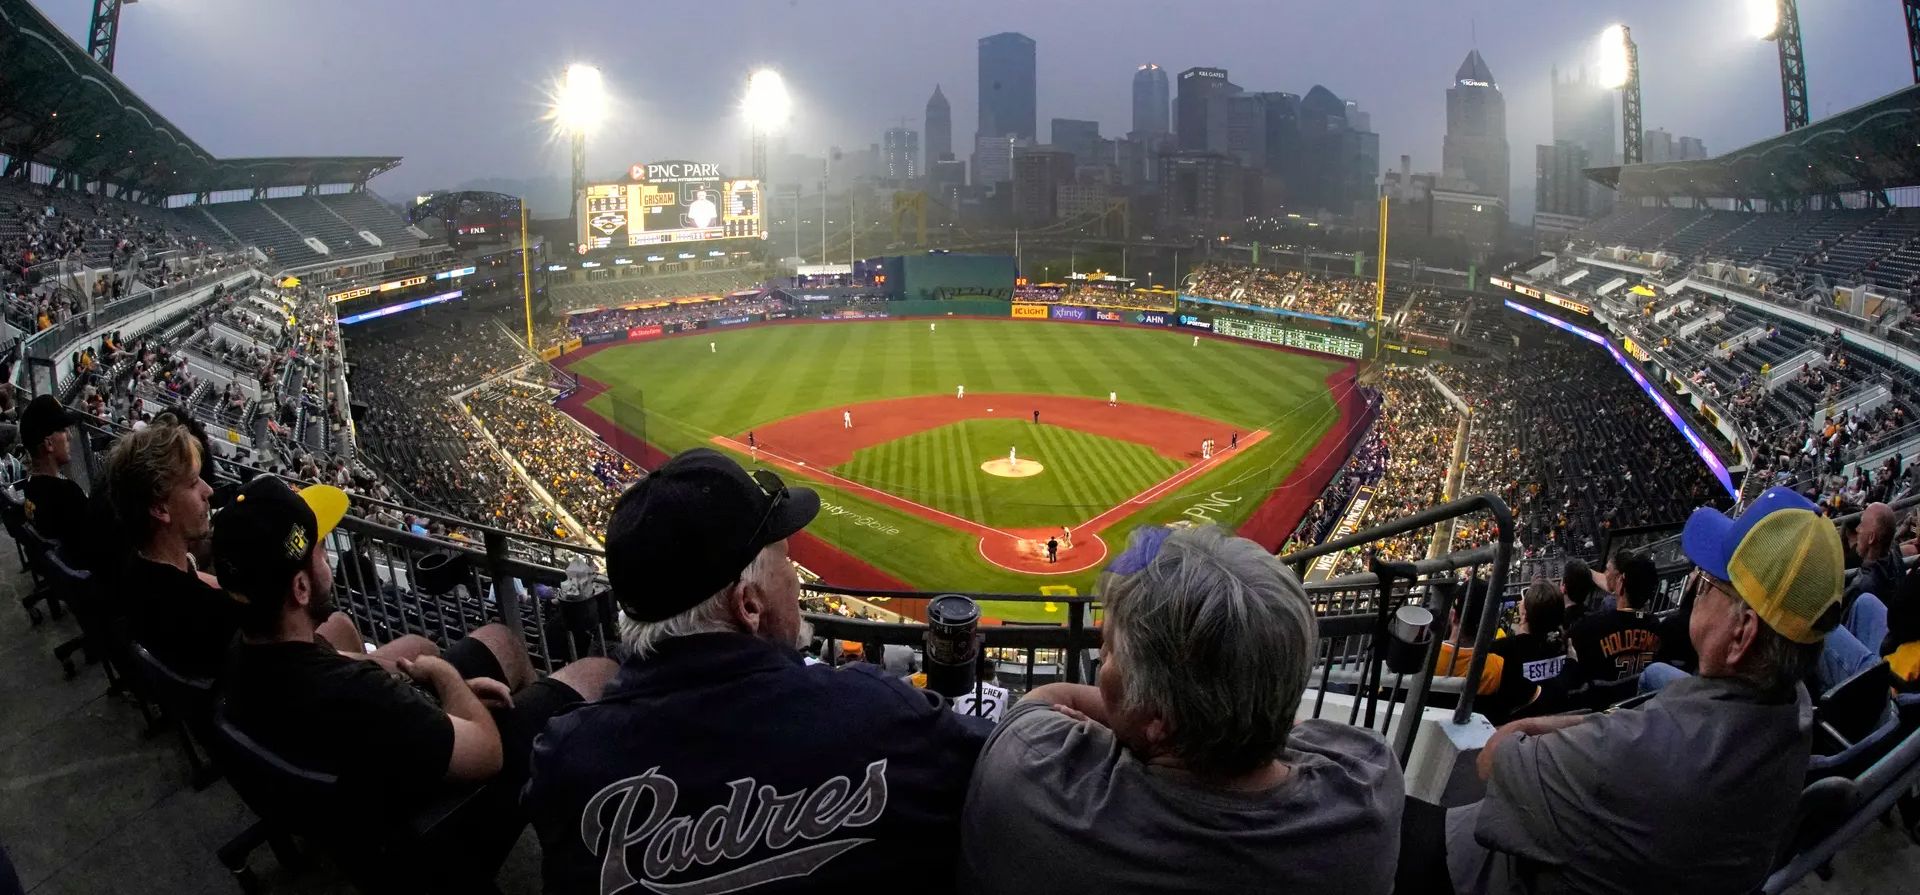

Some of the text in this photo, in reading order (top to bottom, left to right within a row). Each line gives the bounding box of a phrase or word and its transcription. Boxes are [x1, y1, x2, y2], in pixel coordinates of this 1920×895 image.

[648, 163, 720, 178] PNC PARK
[644, 194, 674, 205] GRISHAM
[1055, 308, 1083, 319] xfinity
[1096, 311, 1120, 321] FedEx
[1146, 316, 1164, 324] AHN
[1181, 491, 1242, 520] PNC
[1529, 662, 1547, 680] EST
[964, 698, 996, 719] 22
[580, 757, 889, 895] Padres
